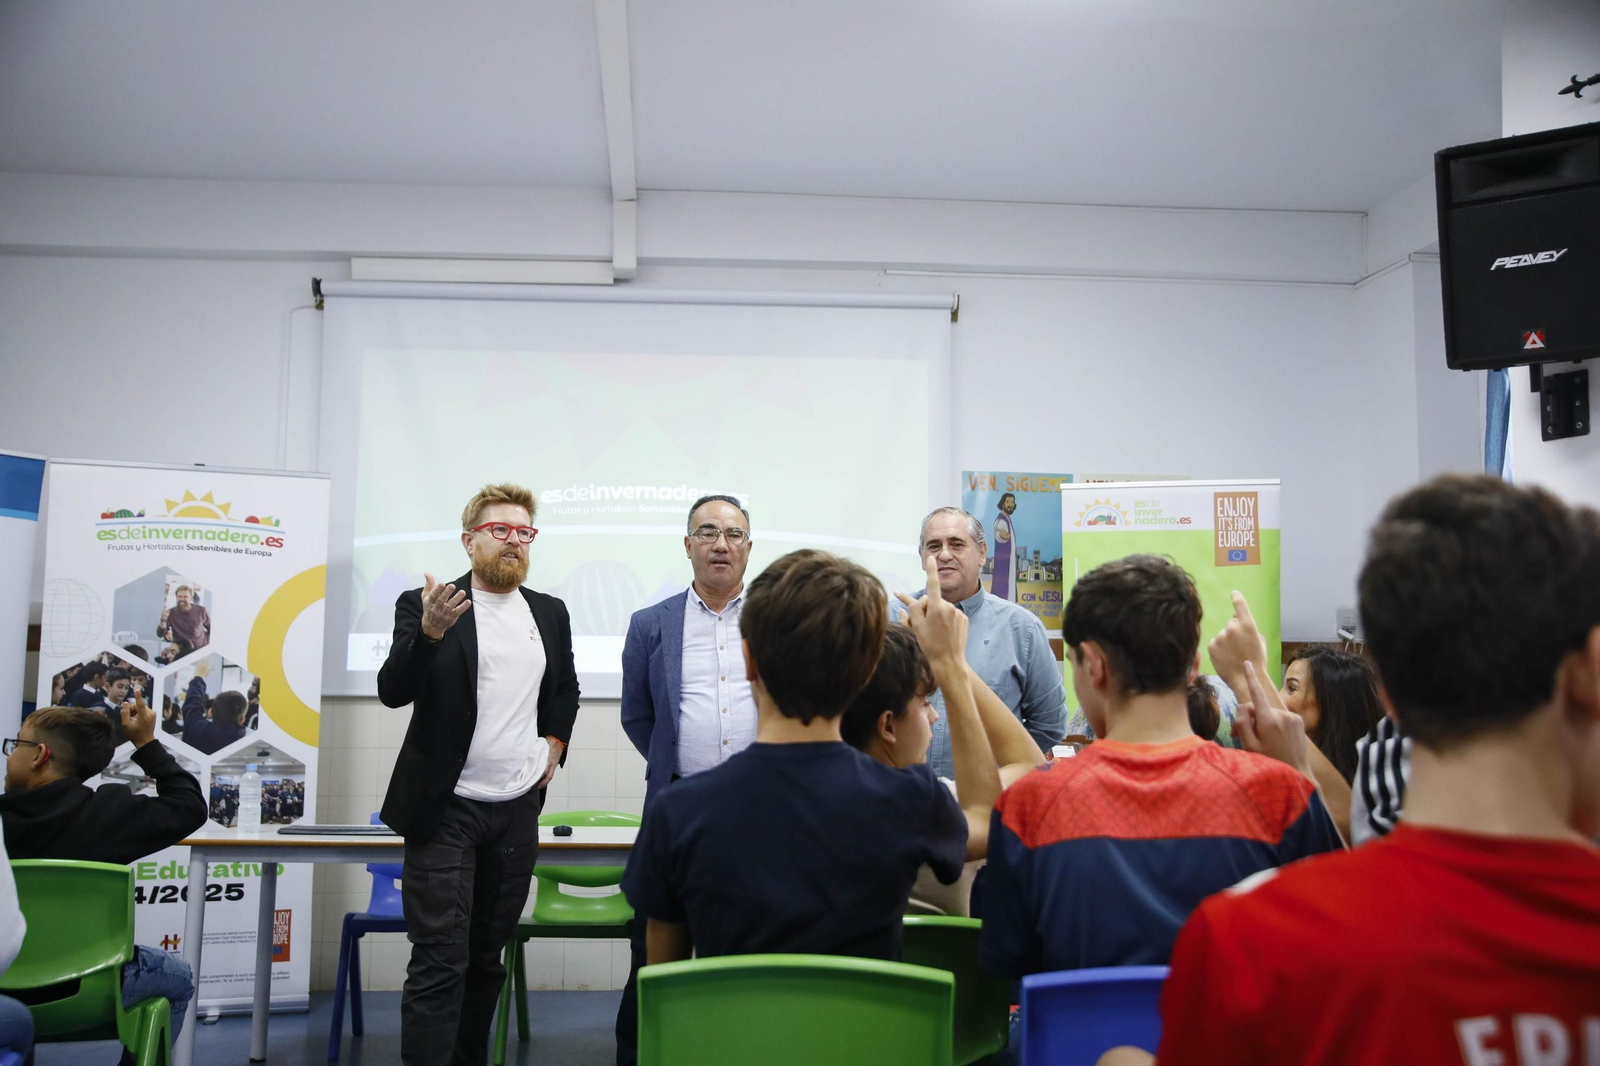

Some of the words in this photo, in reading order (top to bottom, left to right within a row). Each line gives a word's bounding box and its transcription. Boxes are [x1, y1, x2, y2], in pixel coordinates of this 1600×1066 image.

[1490, 248, 1568, 270] PEAVEY
[1134, 499, 1160, 508] esde
[1217, 497, 1255, 517] ENJOY
[1134, 508, 1163, 516] inver
[1134, 516, 1192, 525] nadero.es
[1218, 517, 1233, 531] IT'S
[1234, 517, 1255, 531] FROM
[96, 525, 284, 549] esdeinvernadero.es
[1218, 530, 1256, 547] EUROPE
[107, 543, 134, 551] Frutas
[135, 544, 142, 552] y
[143, 542, 185, 551] Hortalizas
[186, 543, 232, 553] Sostenibles
[244, 547, 272, 557] Europa
[1021, 593, 1036, 601] CON
